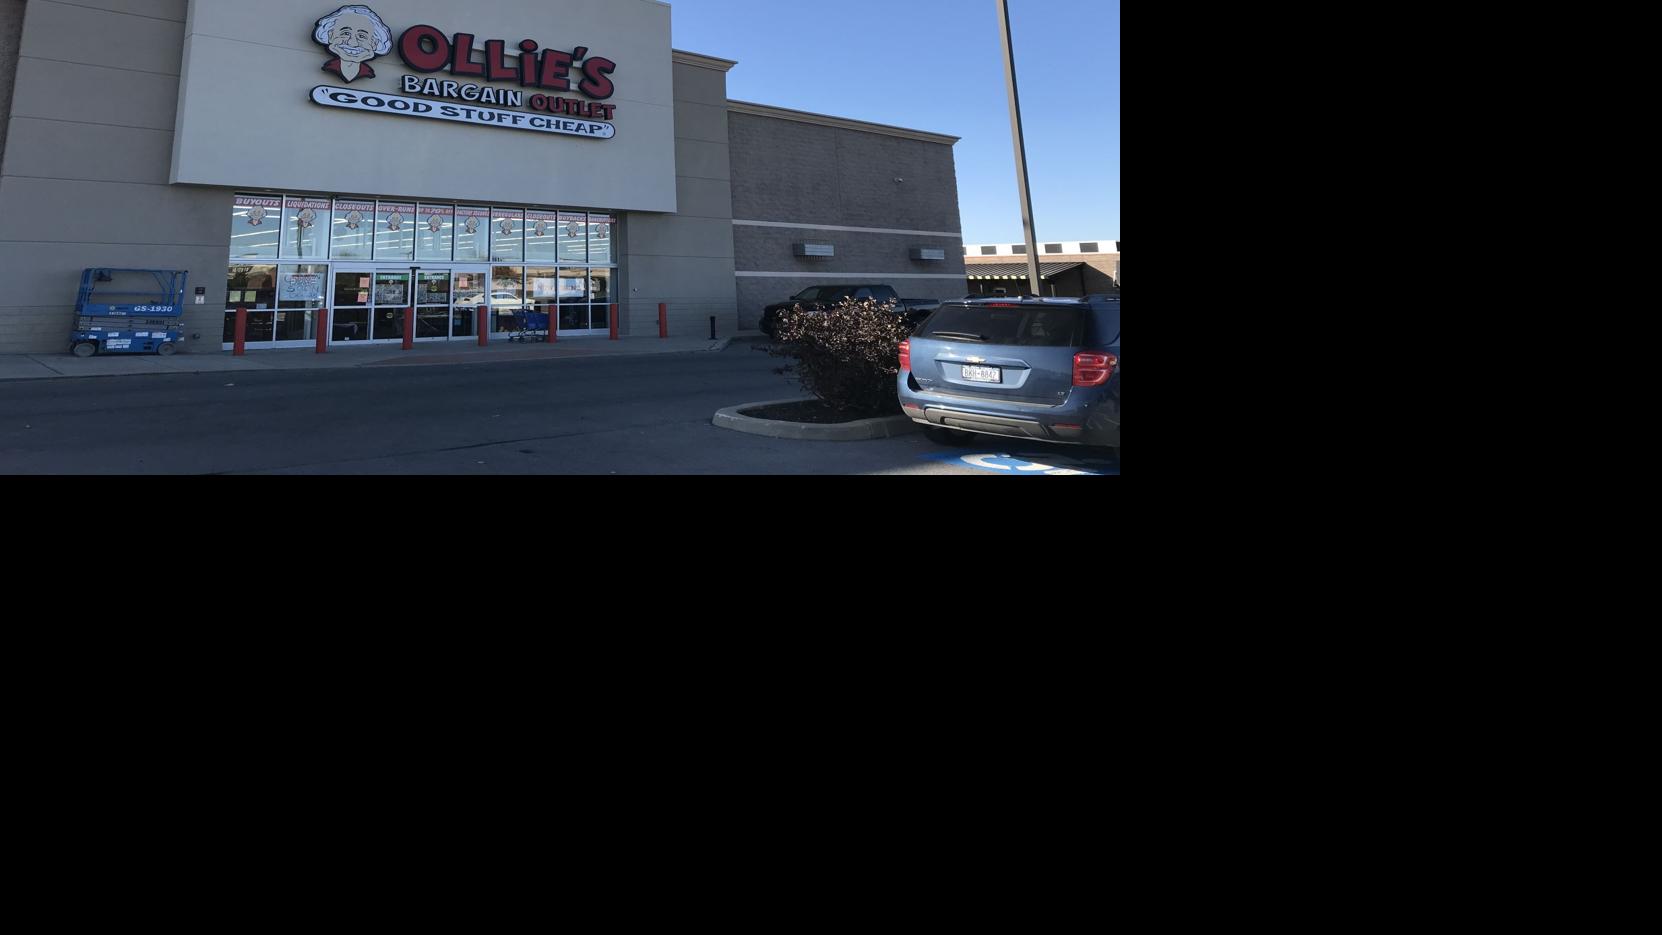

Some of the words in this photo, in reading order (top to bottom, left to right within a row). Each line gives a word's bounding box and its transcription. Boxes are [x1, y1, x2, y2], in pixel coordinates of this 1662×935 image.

[402, 75, 523, 107] BARGAIN
[529, 93, 617, 120] OUTLET
[440, 105, 525, 125] STUFF
[235, 198, 281, 207] BUYOUTS
[287, 200, 330, 209] LIQUIDATIONS
[335, 203, 374, 211] CLOSEOUTS
